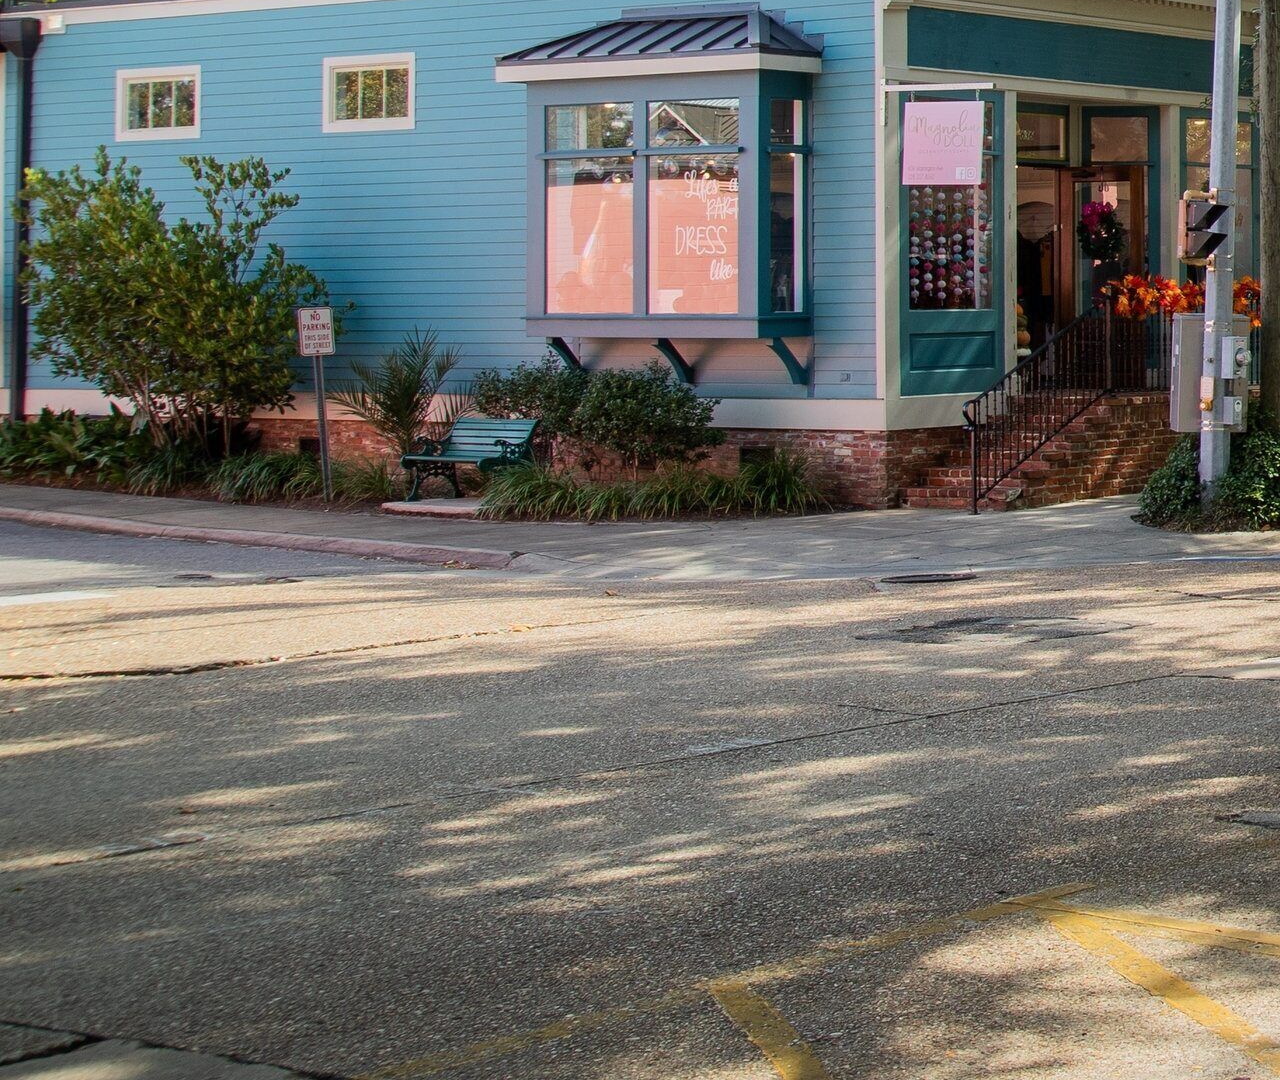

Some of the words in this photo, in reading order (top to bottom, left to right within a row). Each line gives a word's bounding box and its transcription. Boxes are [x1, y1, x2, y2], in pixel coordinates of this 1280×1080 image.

[908, 109, 981, 146] Magnolia
[944, 134, 977, 148] DOLL
[706, 196, 739, 221] PART
[675, 225, 728, 256] DRESS
[710, 258, 738, 281] like
[310, 313, 321, 321] NO
[302, 322, 331, 332] PARKING
[304, 334, 317, 342] THIS
[317, 333, 330, 341] SIDE
[304, 342, 312, 350] OF
[312, 341, 331, 349] STREET
